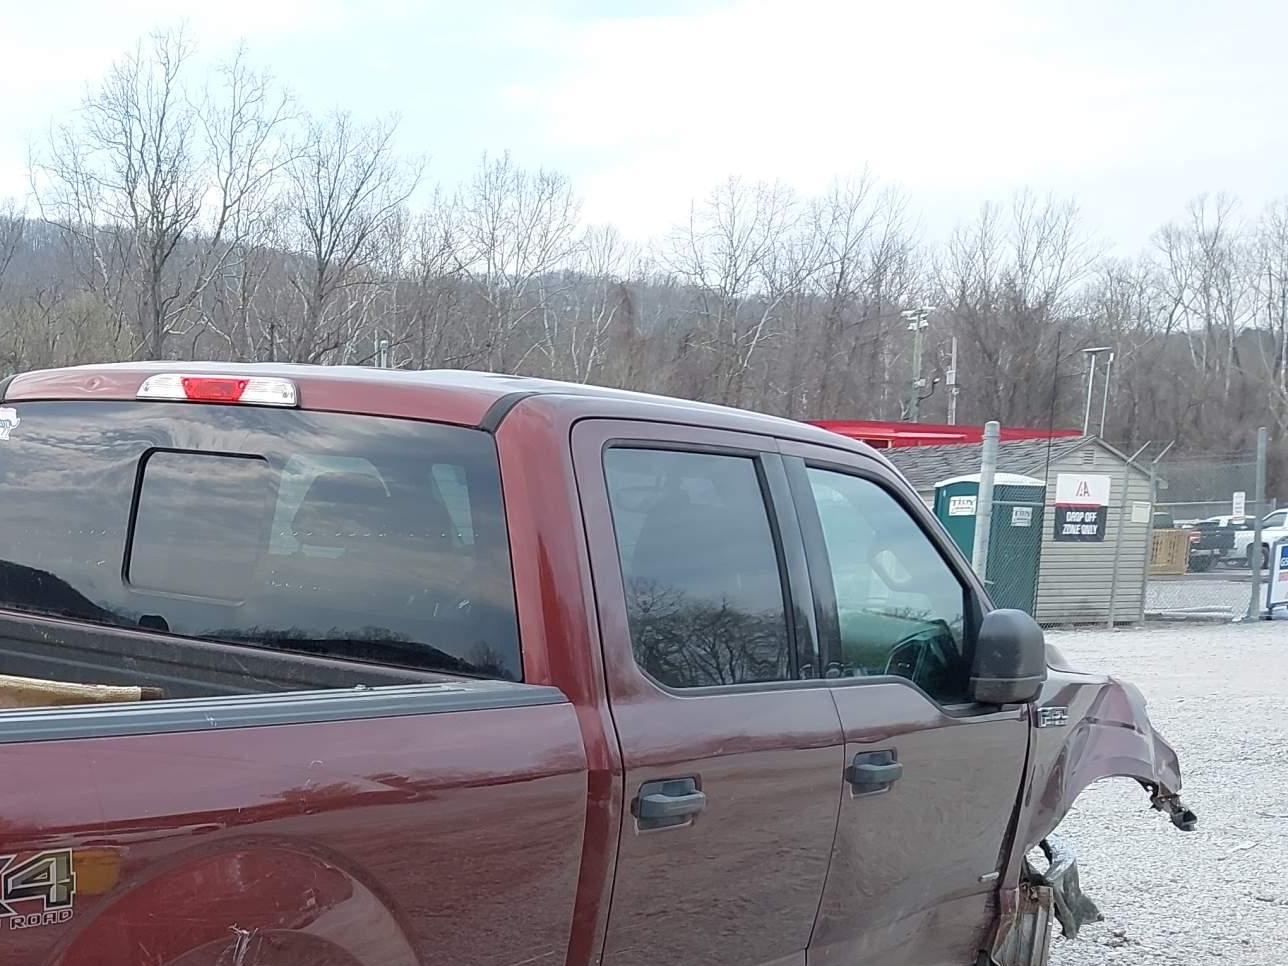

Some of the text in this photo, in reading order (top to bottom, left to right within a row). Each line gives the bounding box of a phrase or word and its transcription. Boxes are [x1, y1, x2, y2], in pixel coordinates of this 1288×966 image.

[1065, 511, 1098, 523] DROP OFF
[1062, 523, 1098, 535] ZONE ONLY
[9, 908, 74, 931] ROAD
